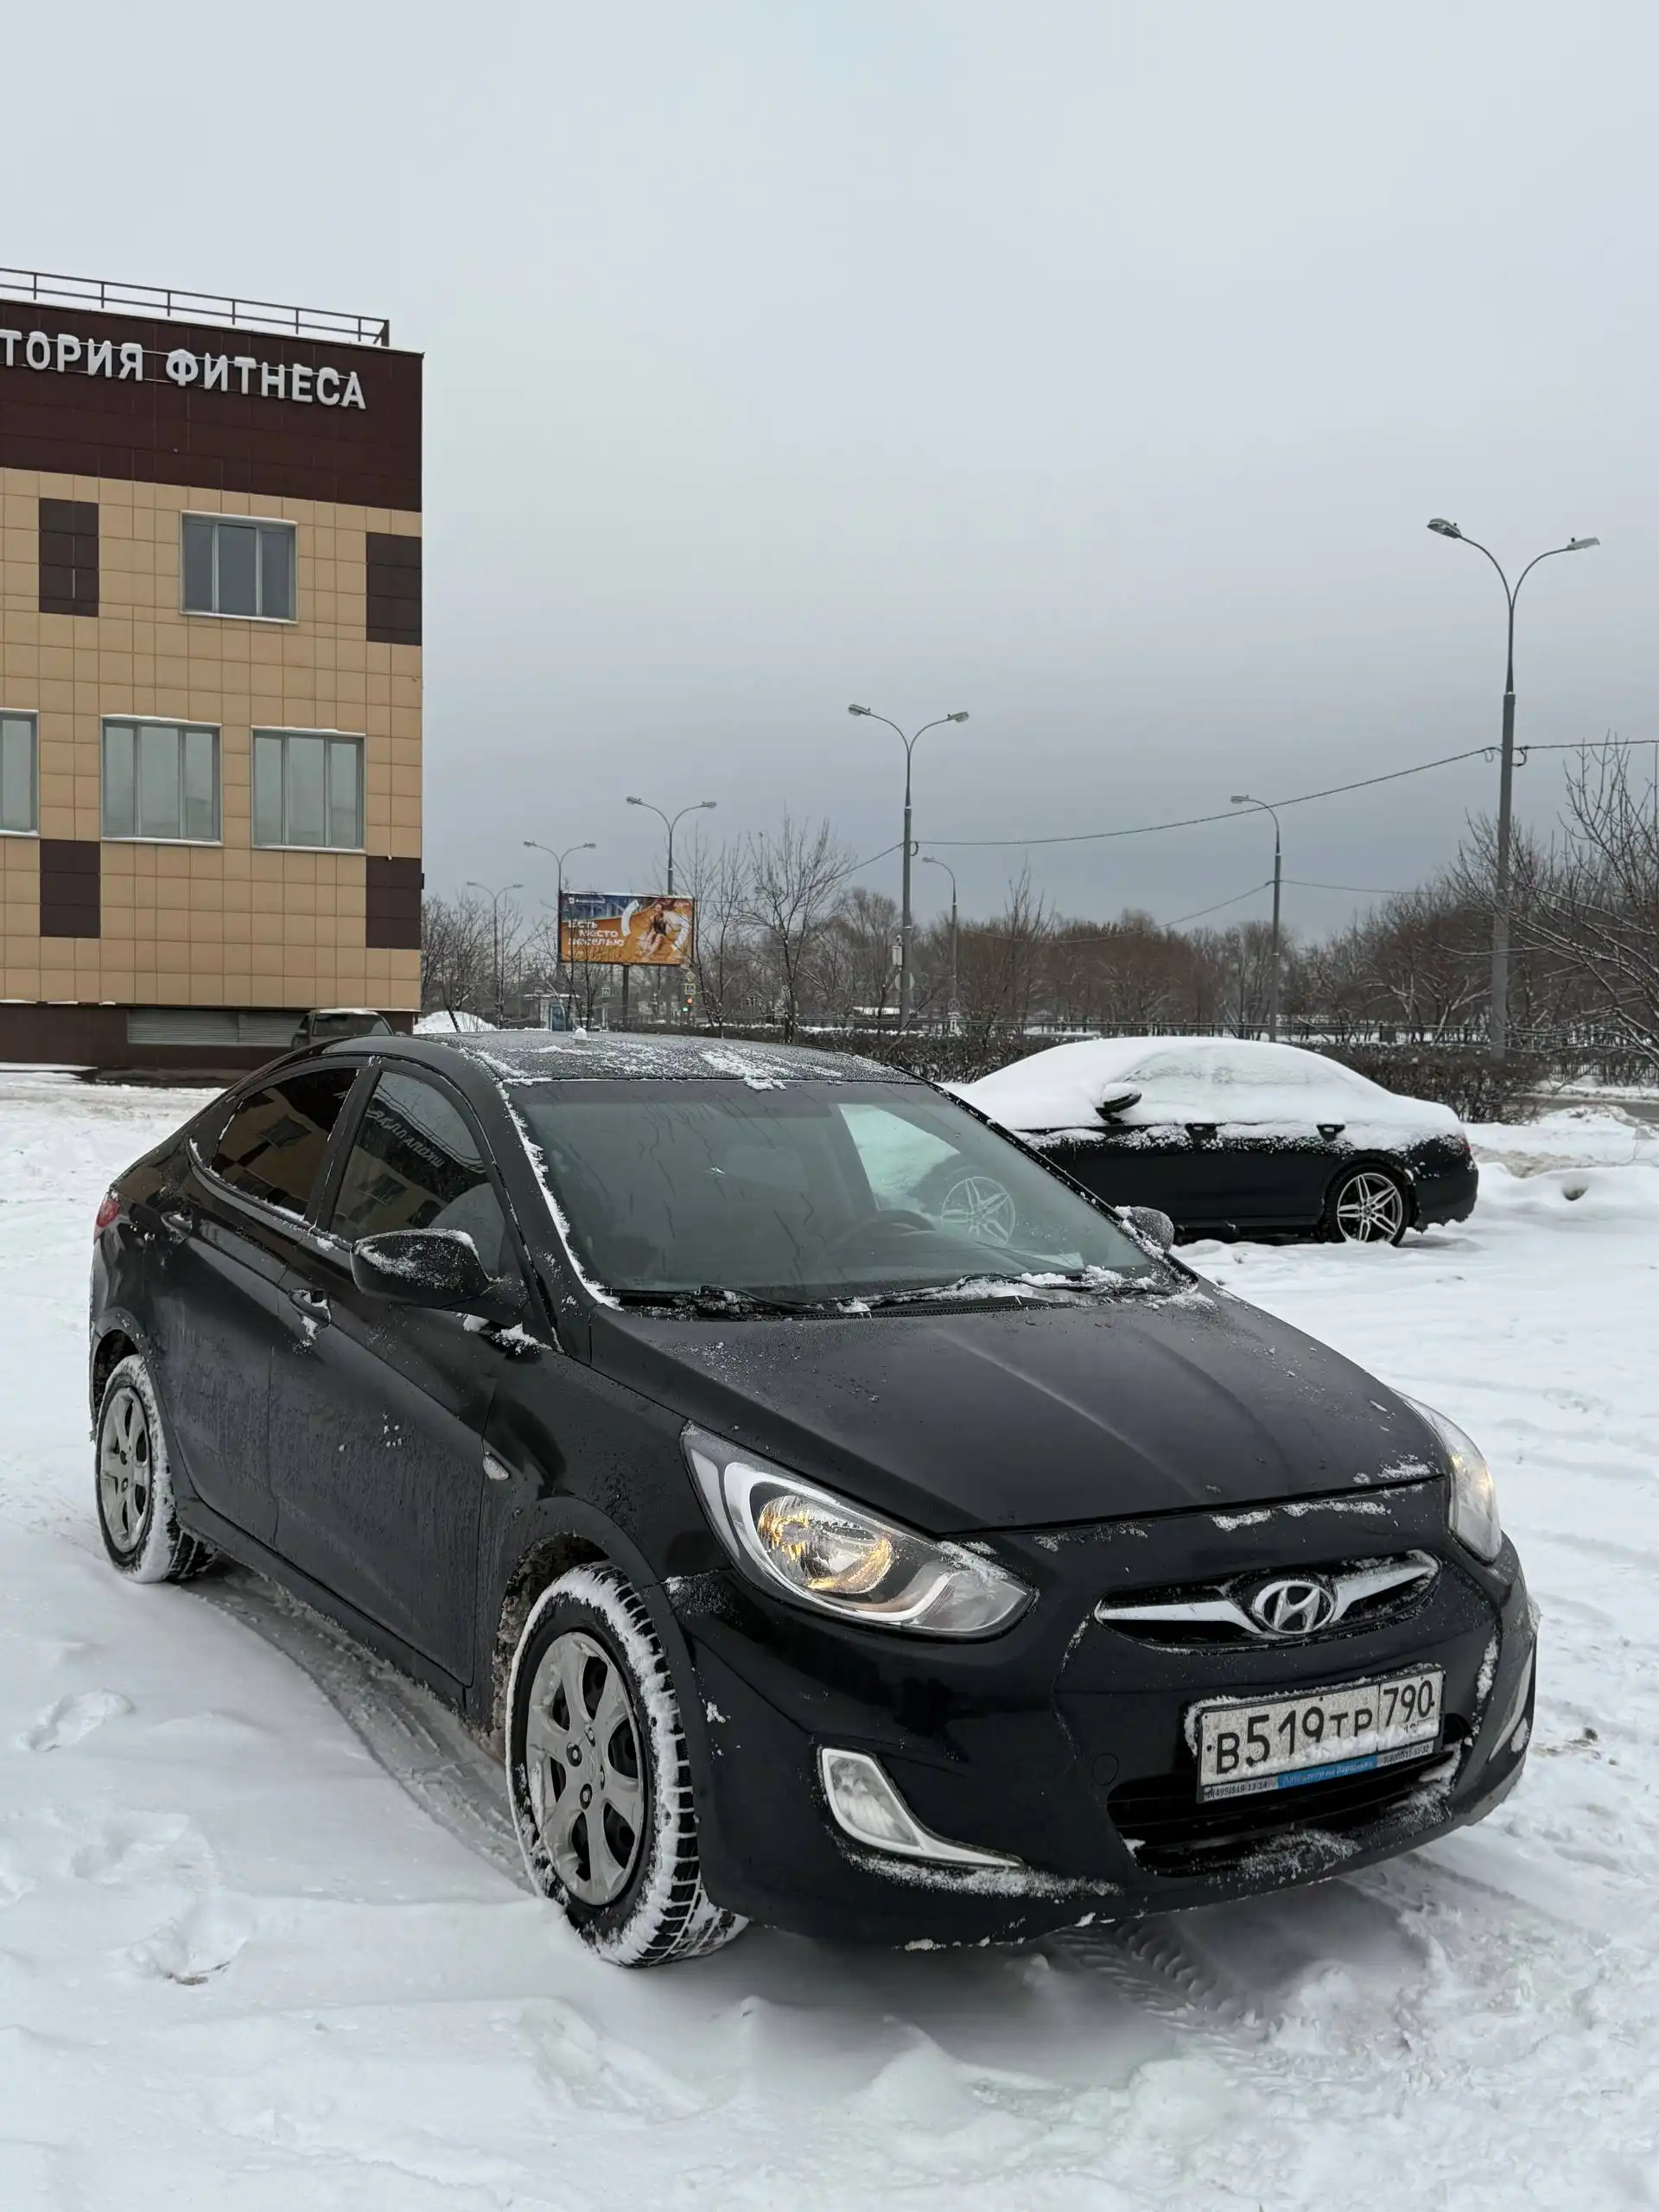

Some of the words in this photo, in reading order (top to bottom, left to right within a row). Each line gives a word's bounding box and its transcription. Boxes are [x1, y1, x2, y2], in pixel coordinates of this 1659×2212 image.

[0, 329, 143, 381] ТОРИЯ
[166, 349, 365, 410] ФИТНЕСА
[1216, 1706, 1373, 1775] В519ТР
[1382, 1681, 1433, 1727] 790
